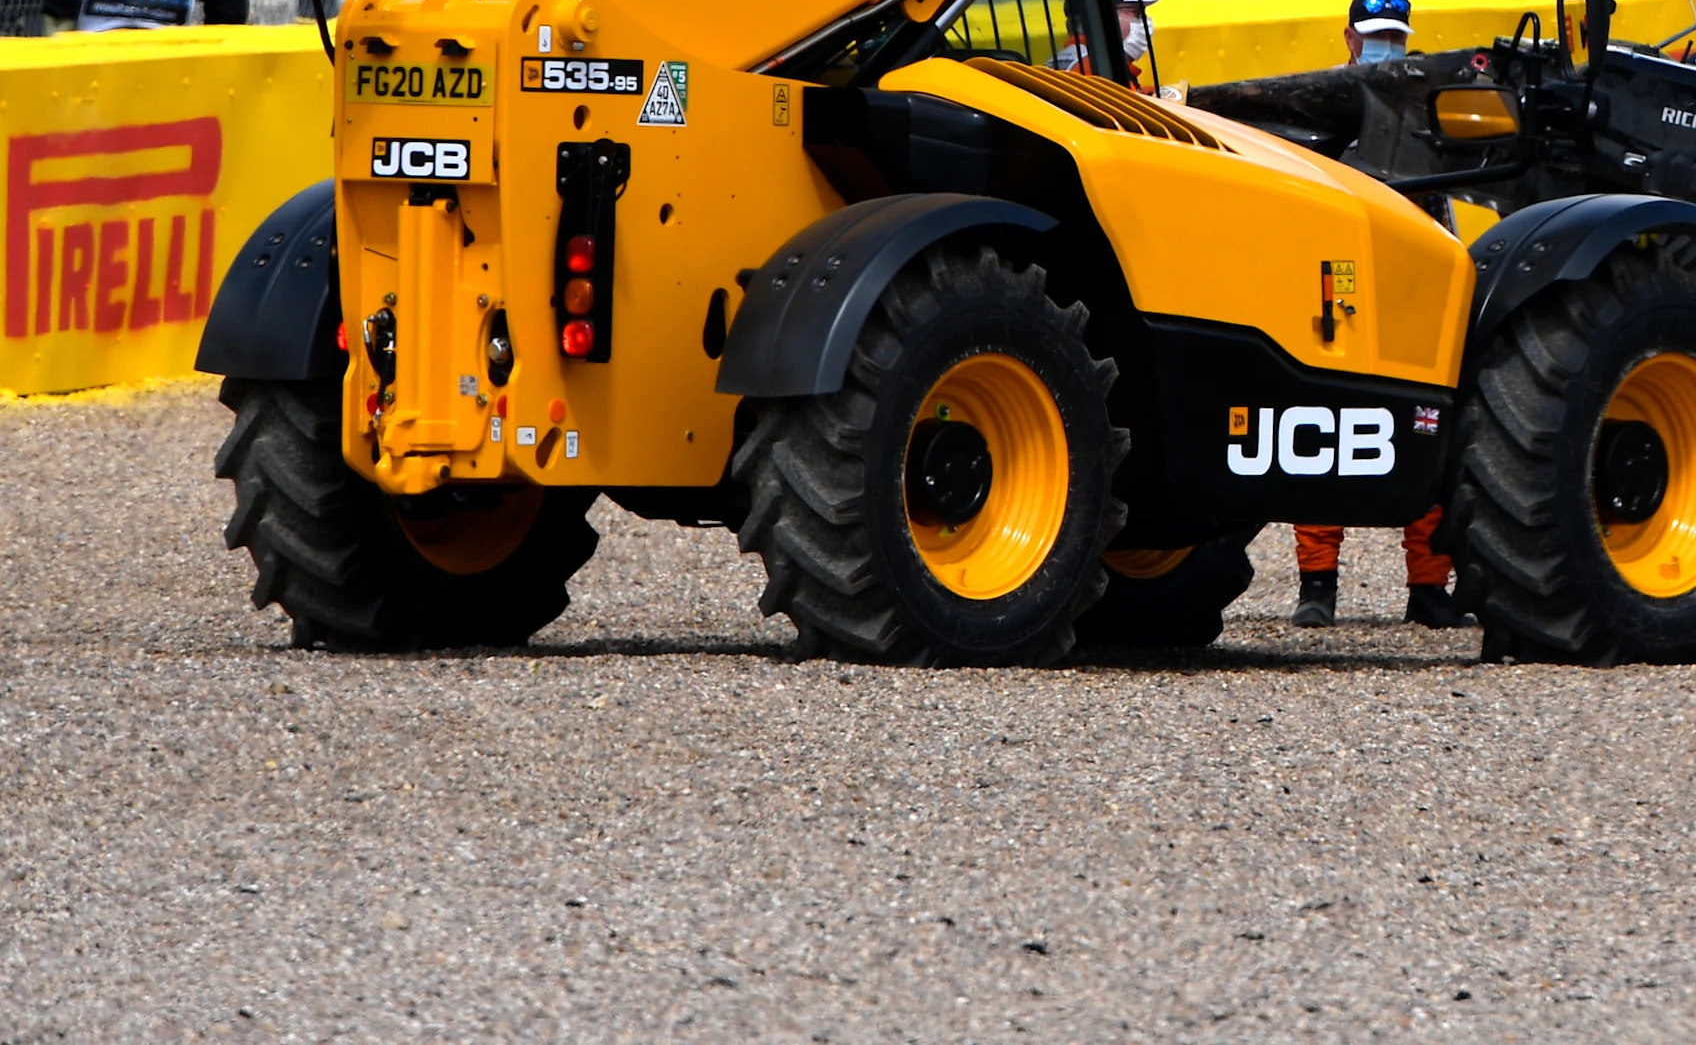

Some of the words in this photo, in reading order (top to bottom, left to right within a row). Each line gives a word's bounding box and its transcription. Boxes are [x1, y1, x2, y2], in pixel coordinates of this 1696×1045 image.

[357, 65, 423, 97] FG20
[432, 67, 482, 98] AZD
[373, 141, 468, 178] JCB
[5, 116, 222, 338] PIRELLI
[1227, 405, 1396, 476] JCB
